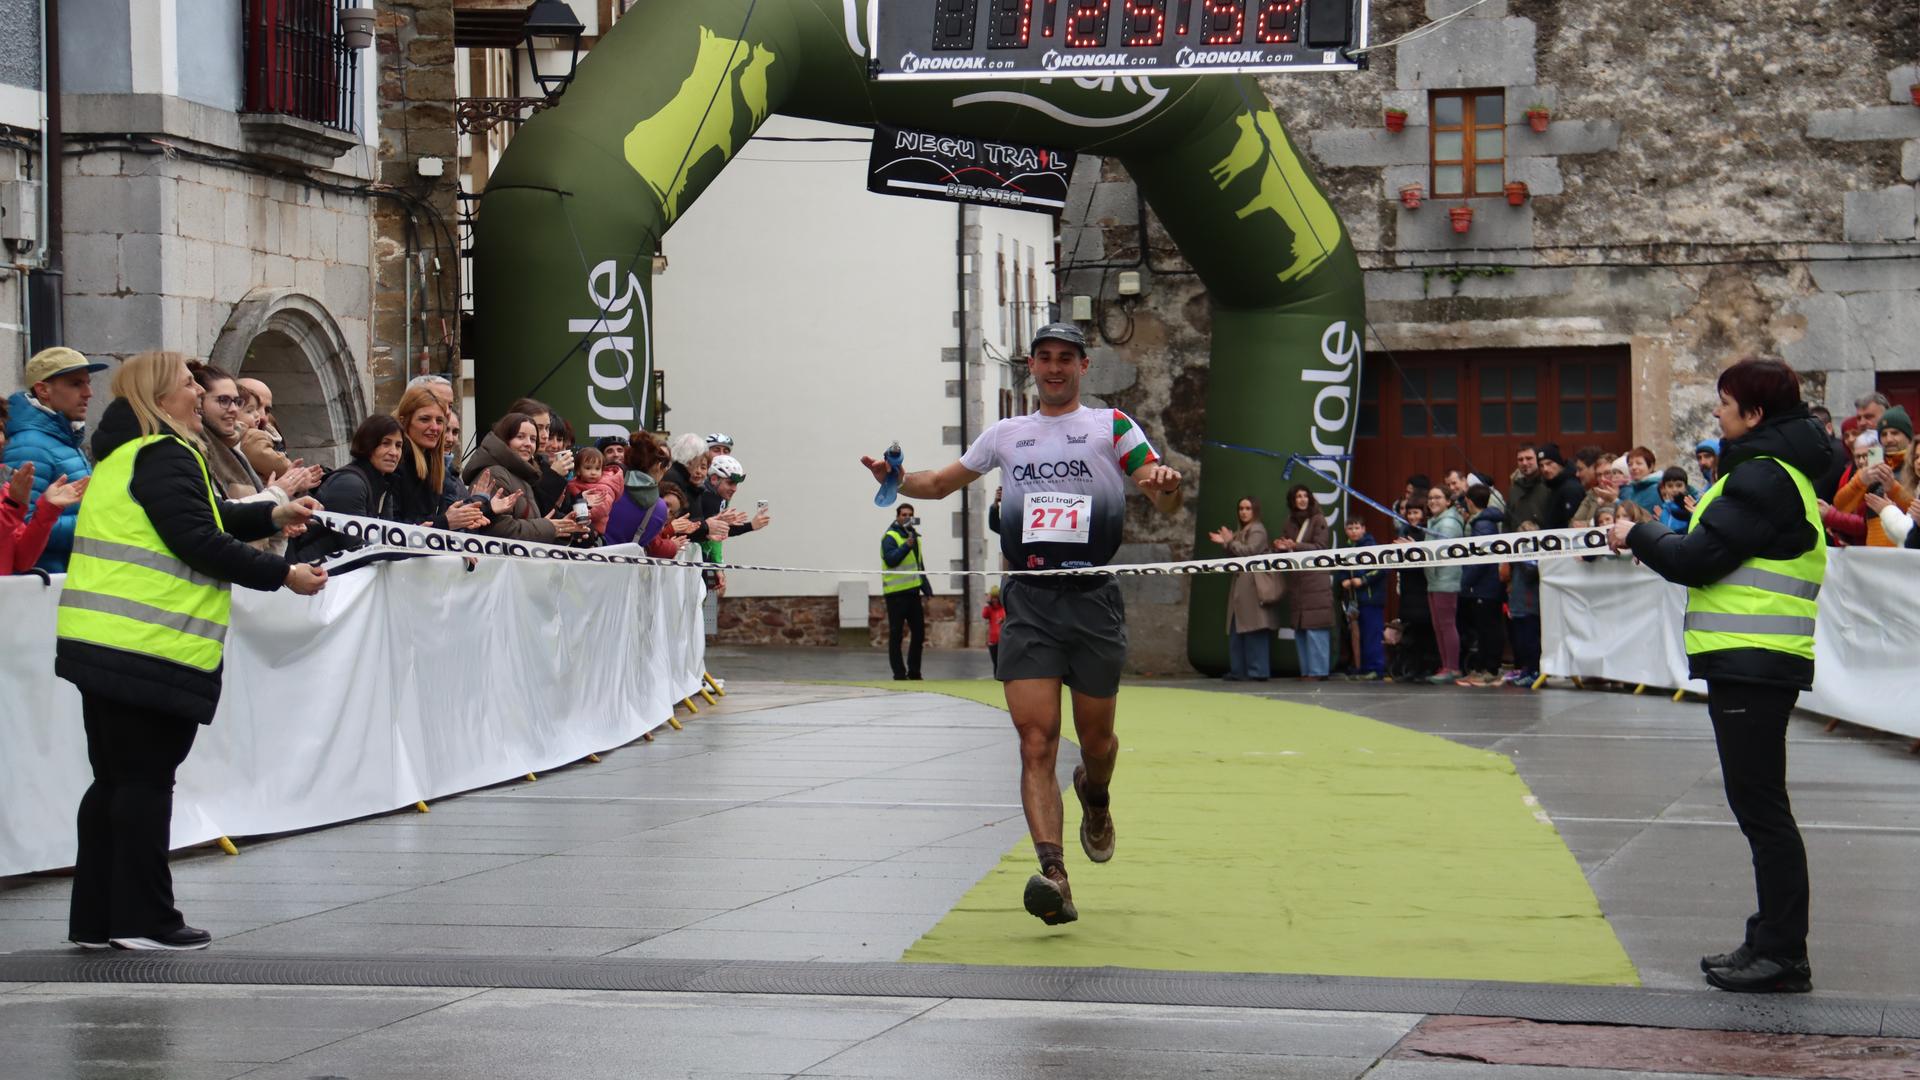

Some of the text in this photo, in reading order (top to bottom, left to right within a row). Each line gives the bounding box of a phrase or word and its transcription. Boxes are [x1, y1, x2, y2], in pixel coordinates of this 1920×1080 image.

[900, 52, 1015, 73] KRONOAK.com
[1041, 49, 1157, 71] KRONOAK.com
[1175, 46, 1293, 68] KRONOAK.com
[896, 130, 975, 159] NEGU
[945, 182, 1024, 206] BERASTEGI
[1012, 460, 1093, 481] CALCOSA
[1031, 496, 1073, 505] NEGU trail
[1030, 507, 1078, 529] 271
